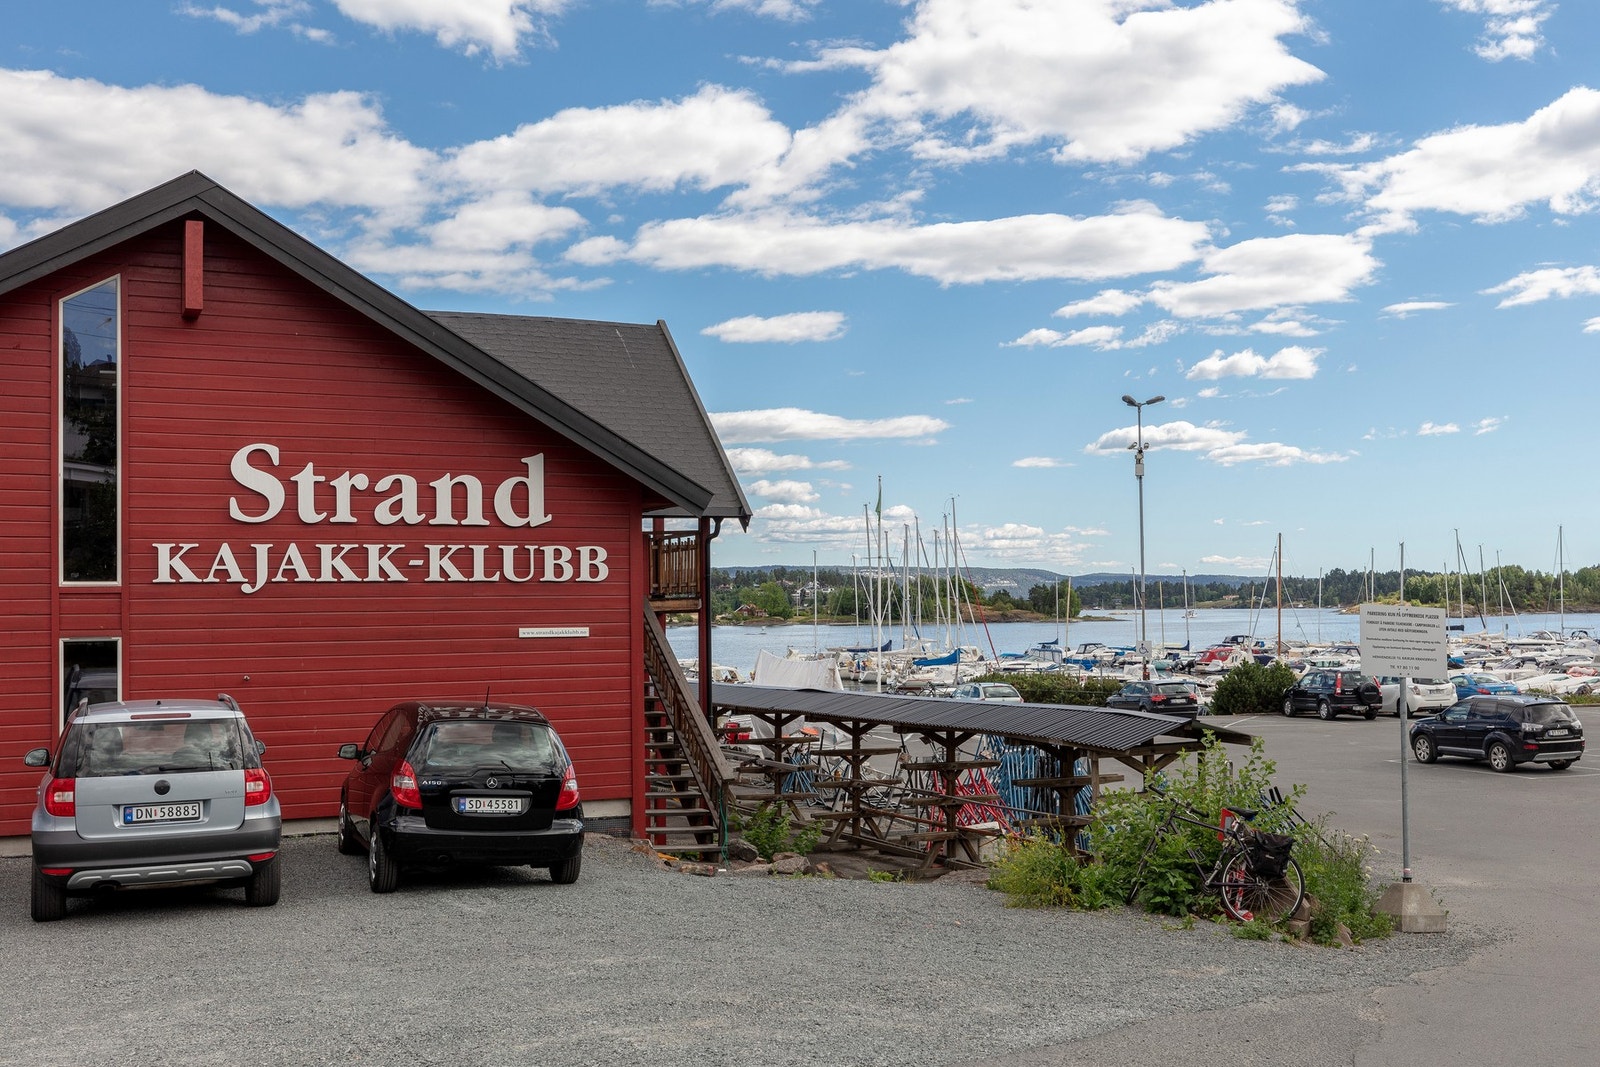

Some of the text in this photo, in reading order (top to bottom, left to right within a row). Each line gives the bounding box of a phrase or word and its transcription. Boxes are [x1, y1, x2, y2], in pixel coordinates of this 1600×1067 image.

[229, 443, 553, 528] Strand
[152, 542, 609, 594] KAJAKK-KLUBB
[160, 805, 197, 817] 58885
[486, 799, 519, 810] 45581
